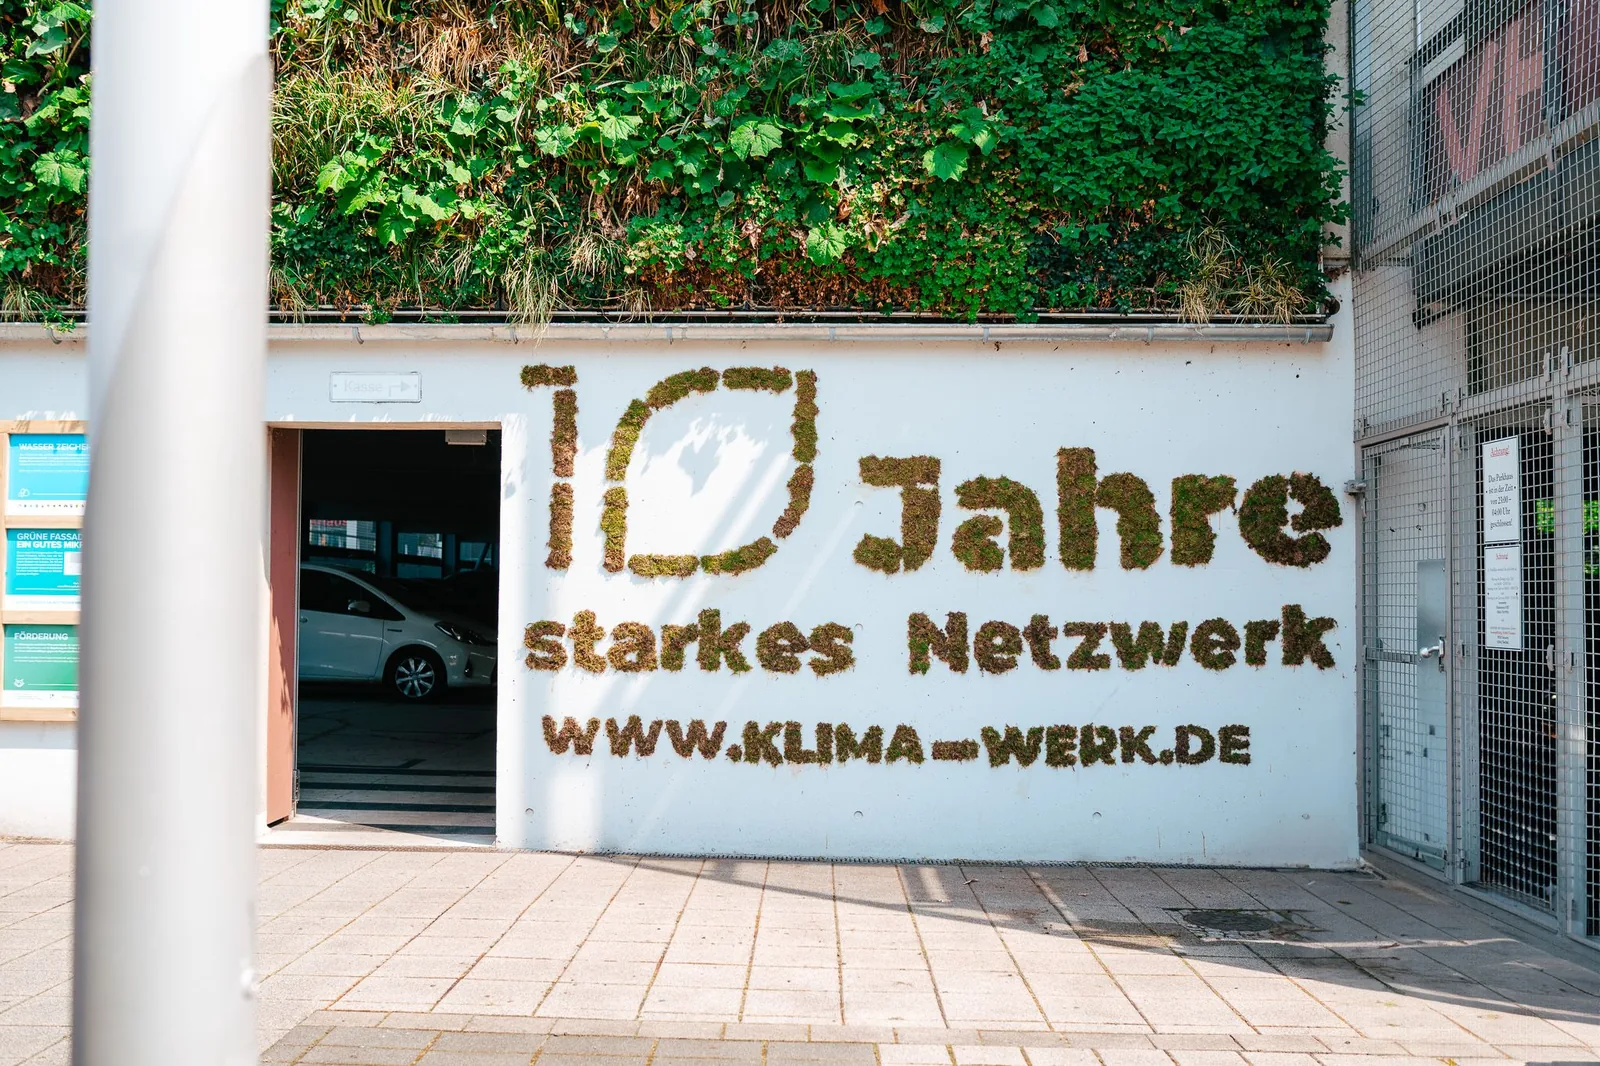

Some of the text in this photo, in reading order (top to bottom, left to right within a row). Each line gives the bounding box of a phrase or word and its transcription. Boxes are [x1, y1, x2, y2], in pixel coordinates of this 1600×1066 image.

[344, 380, 383, 392] Kasse
[521, 365, 1343, 576] 10 Jahre
[1488, 474, 1496, 483] Das
[16, 532, 48, 540] GRÜNE
[16, 541, 31, 549] EIN
[33, 541, 62, 549] GUTES
[14, 631, 69, 640] FÖRDERUNG
[524, 604, 1337, 676] starkes Netzwerk
